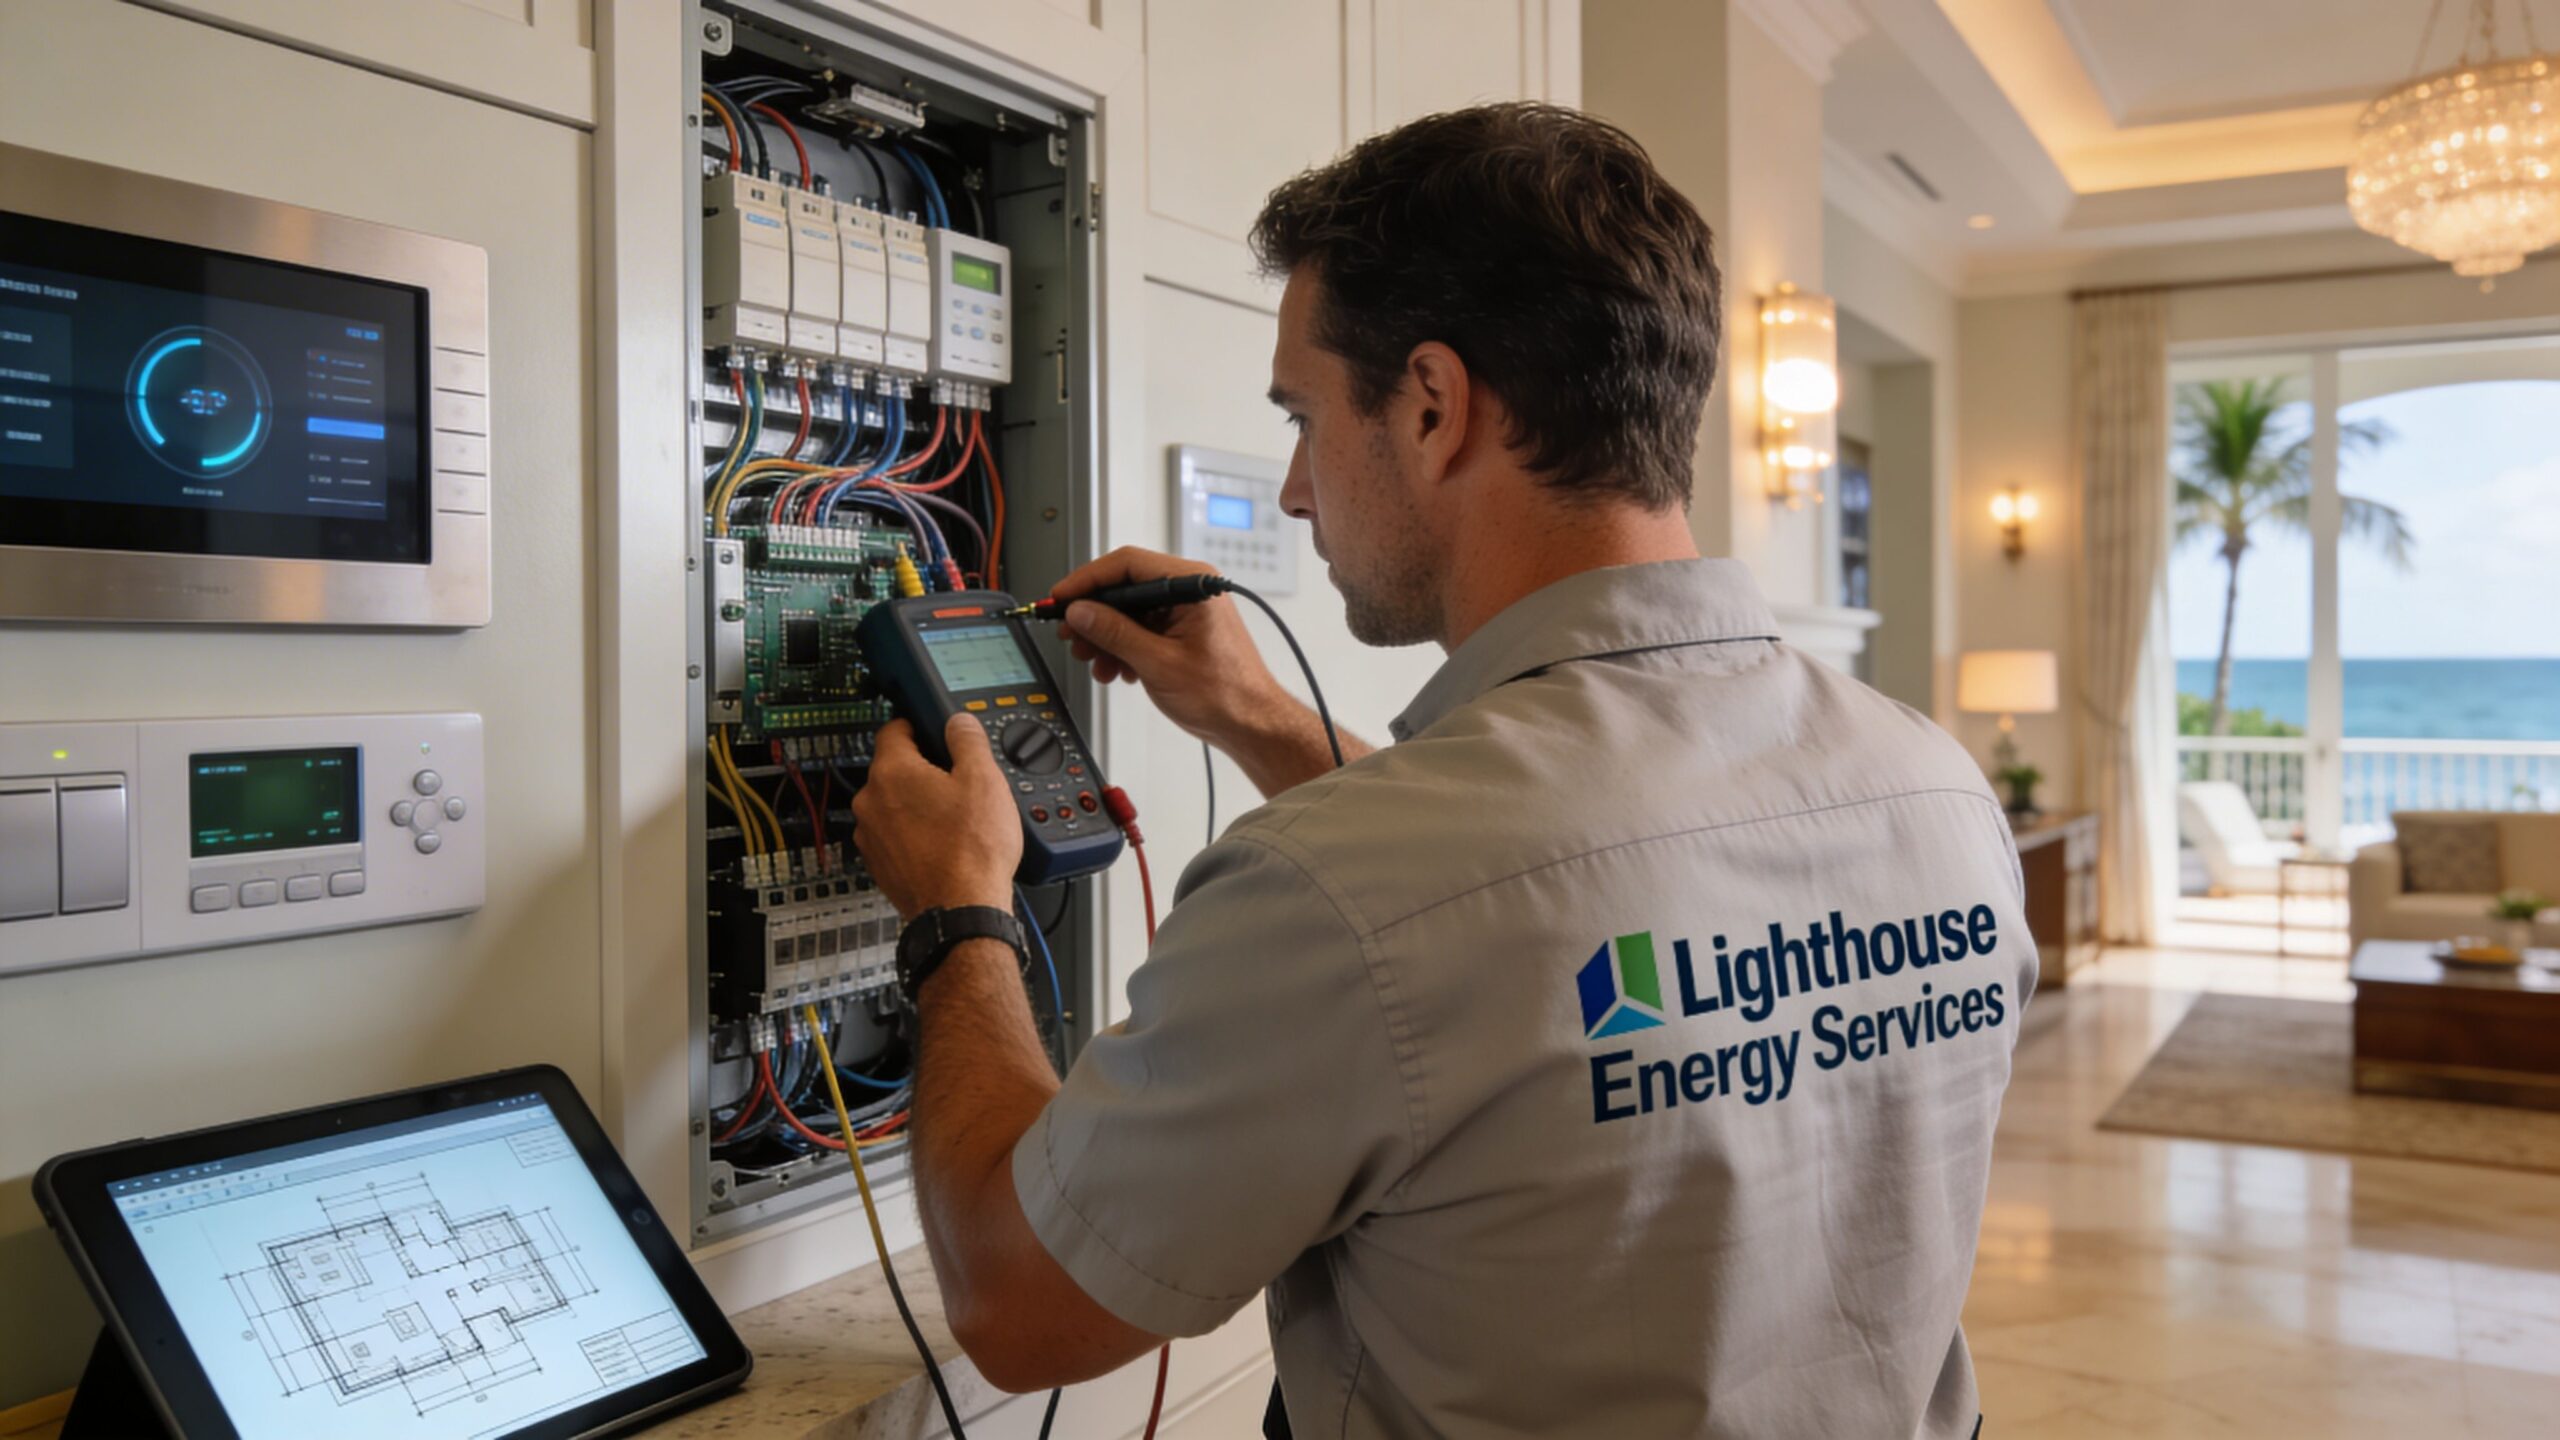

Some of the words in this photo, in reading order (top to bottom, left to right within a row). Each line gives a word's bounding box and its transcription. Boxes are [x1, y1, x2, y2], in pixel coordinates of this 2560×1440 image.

[1672, 903, 1998, 1022] Lighthouse
[1590, 1030, 1801, 1124] Energy
[1811, 982, 2005, 1071] Services
